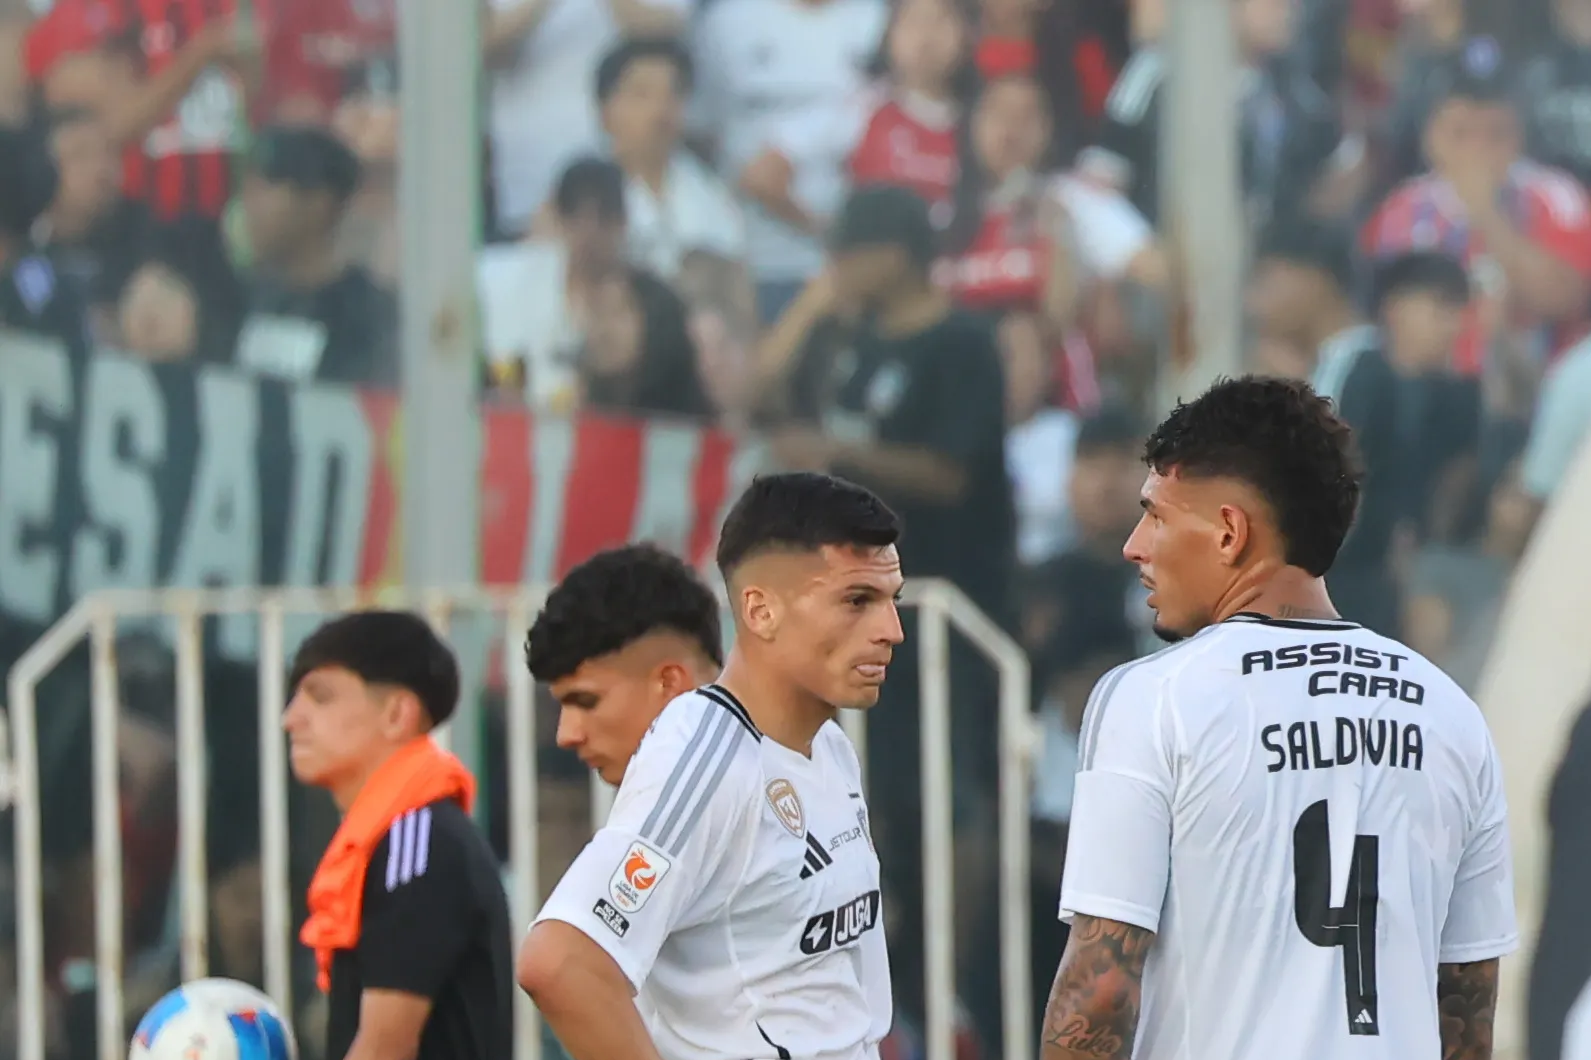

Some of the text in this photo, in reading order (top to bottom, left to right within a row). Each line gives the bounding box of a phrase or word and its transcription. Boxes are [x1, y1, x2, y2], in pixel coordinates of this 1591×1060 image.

[1242, 642, 1408, 675] ASSIST
[1308, 671, 1425, 705] CARD
[829, 827, 862, 852] JETOUR
[1293, 799, 1379, 1036] 4
